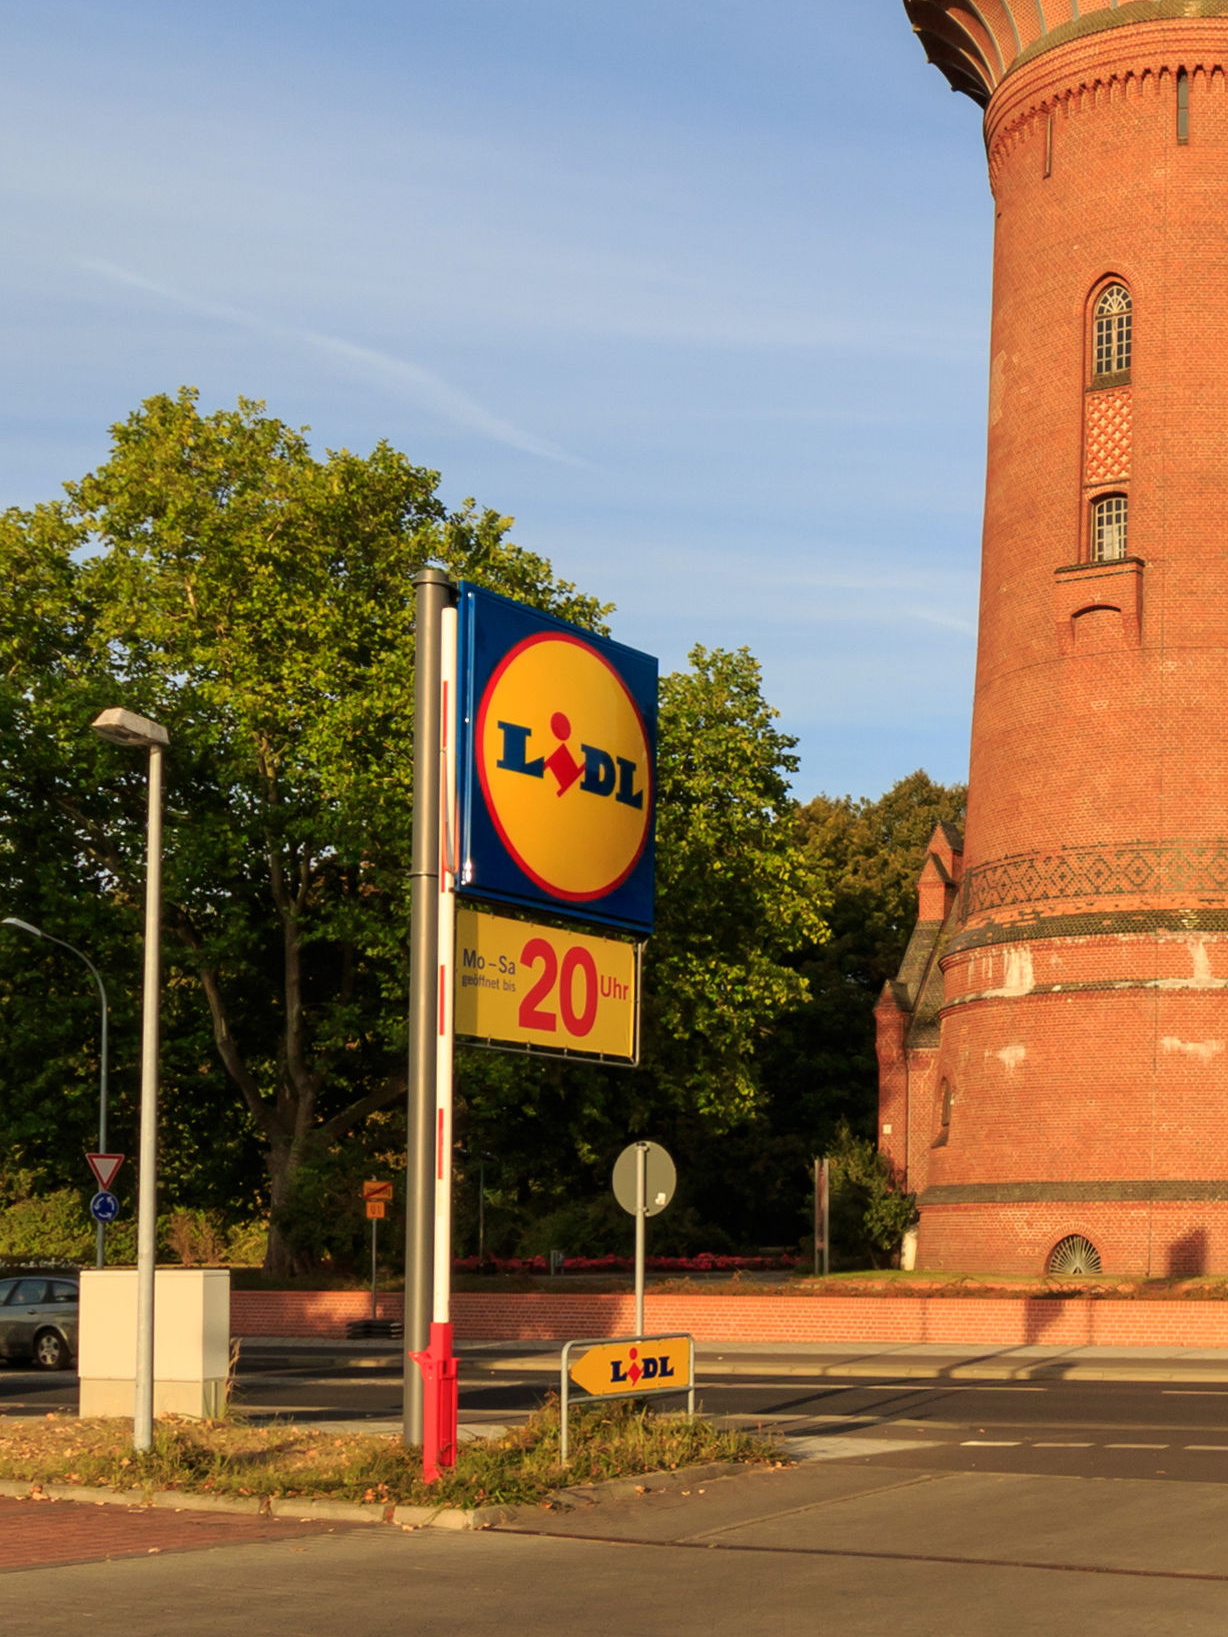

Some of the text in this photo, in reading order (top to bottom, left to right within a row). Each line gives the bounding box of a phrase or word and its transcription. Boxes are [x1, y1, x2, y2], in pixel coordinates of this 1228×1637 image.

[461, 974, 516, 993] geöffnet bis
[518, 937, 629, 1038] 20 Uhr
